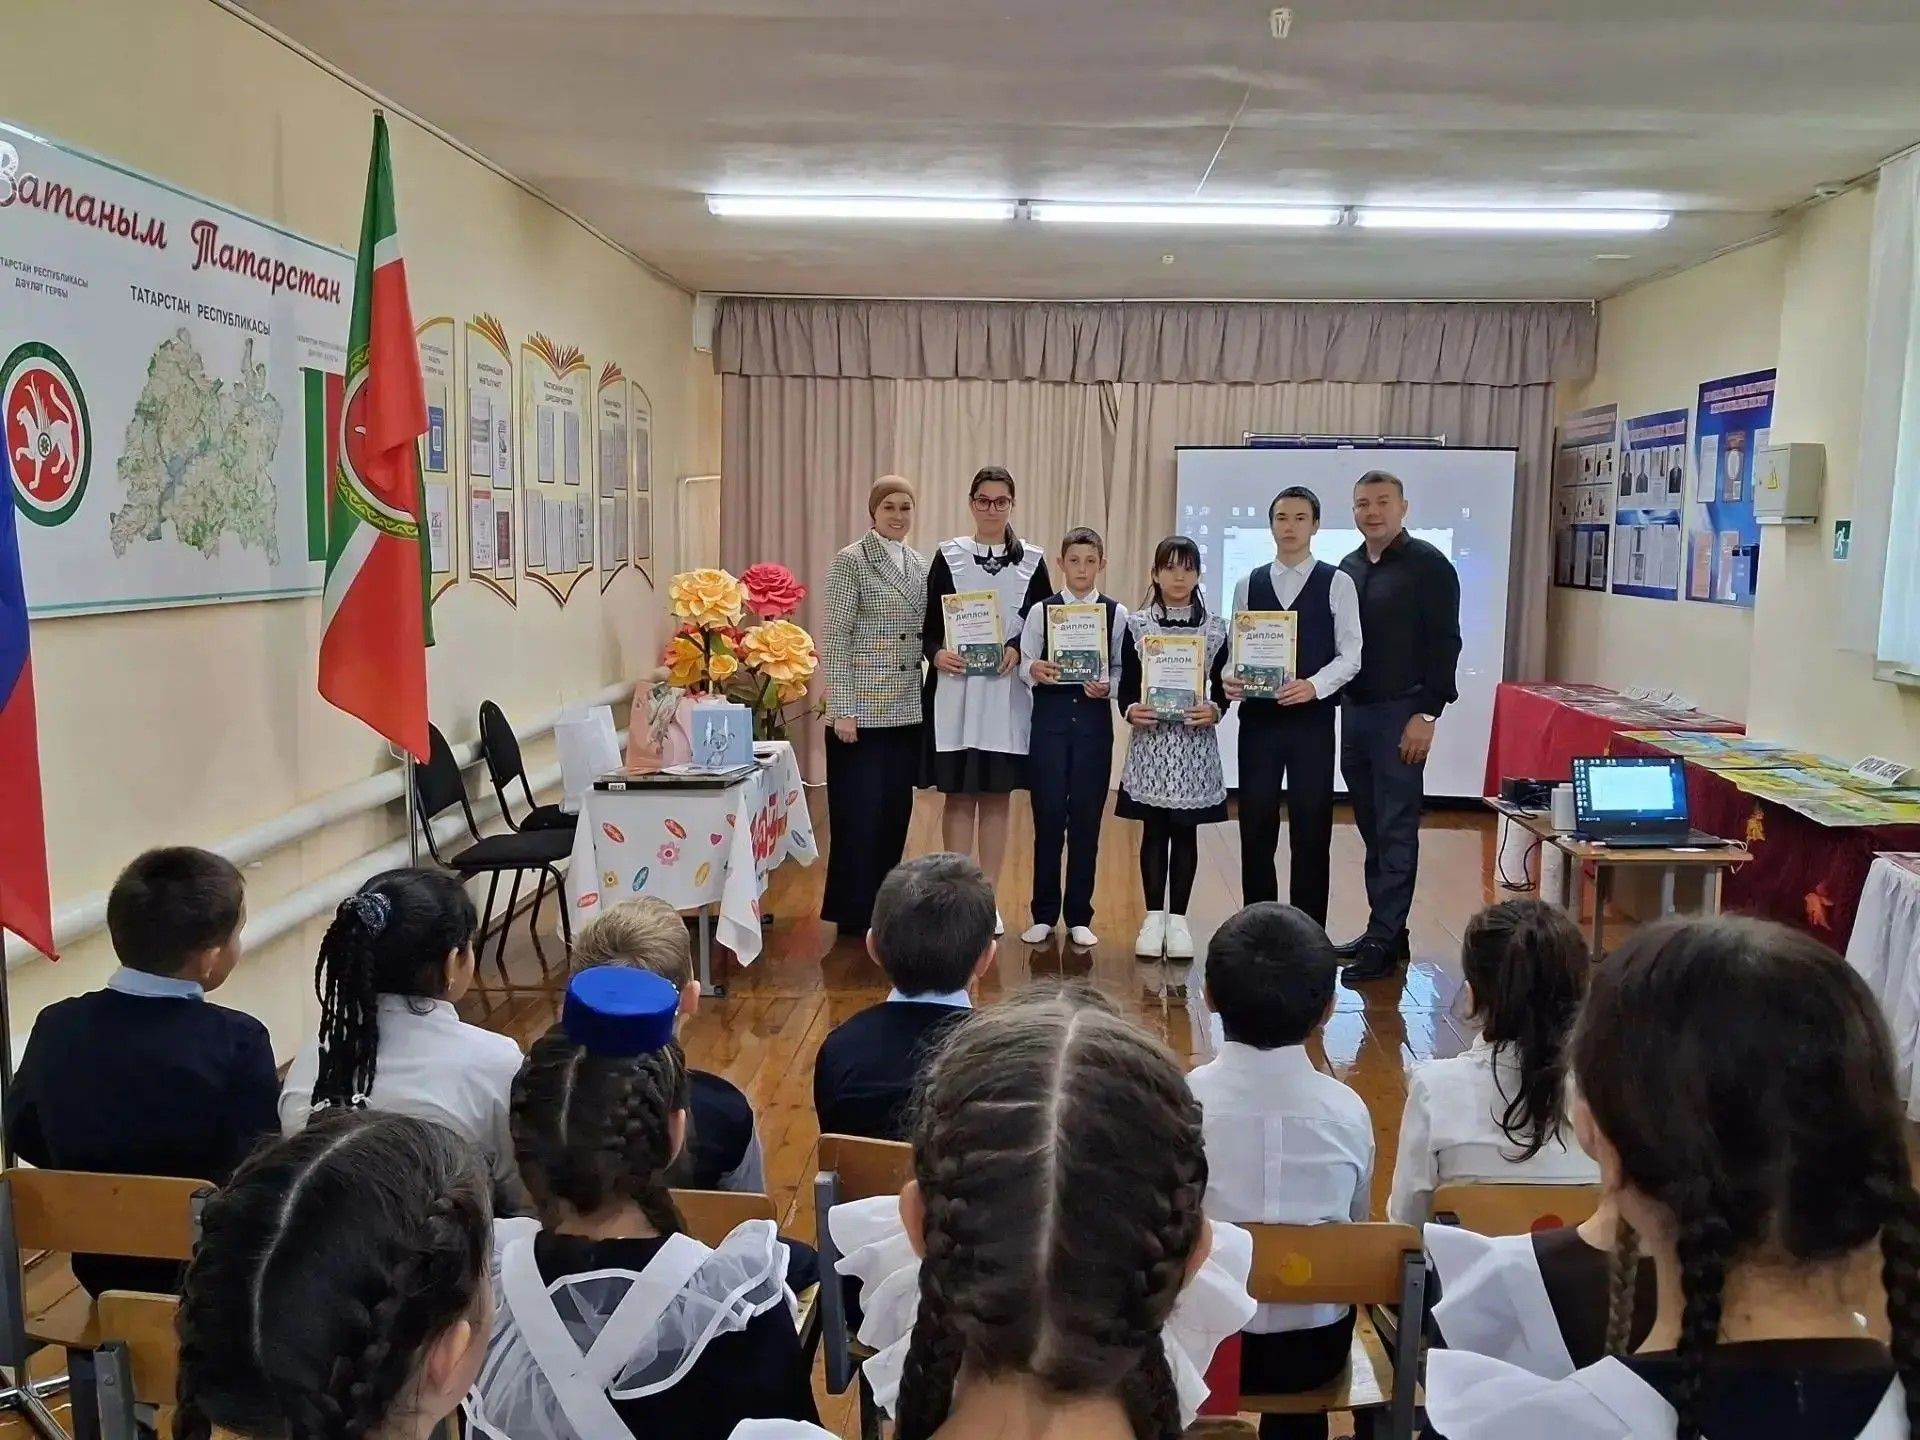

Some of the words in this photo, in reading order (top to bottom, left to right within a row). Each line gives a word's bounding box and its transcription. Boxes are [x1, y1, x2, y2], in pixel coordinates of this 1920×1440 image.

[190, 219, 341, 304] Татарстан
[33, 265, 89, 289] РЕСПУБЛИКАСЫ
[45, 284, 69, 299] ГЕРБЫ
[130, 285, 191, 315] ТАТАРСТАН
[197, 303, 271, 337] РЕСПУБЛИКАСЫ
[955, 610, 990, 621] ДИПЛОМ
[1060, 623, 1096, 631] ДИПЛОМ
[1245, 632, 1284, 640] ДИПЛОМ
[1154, 656, 1192, 664] ДИПЛОМ
